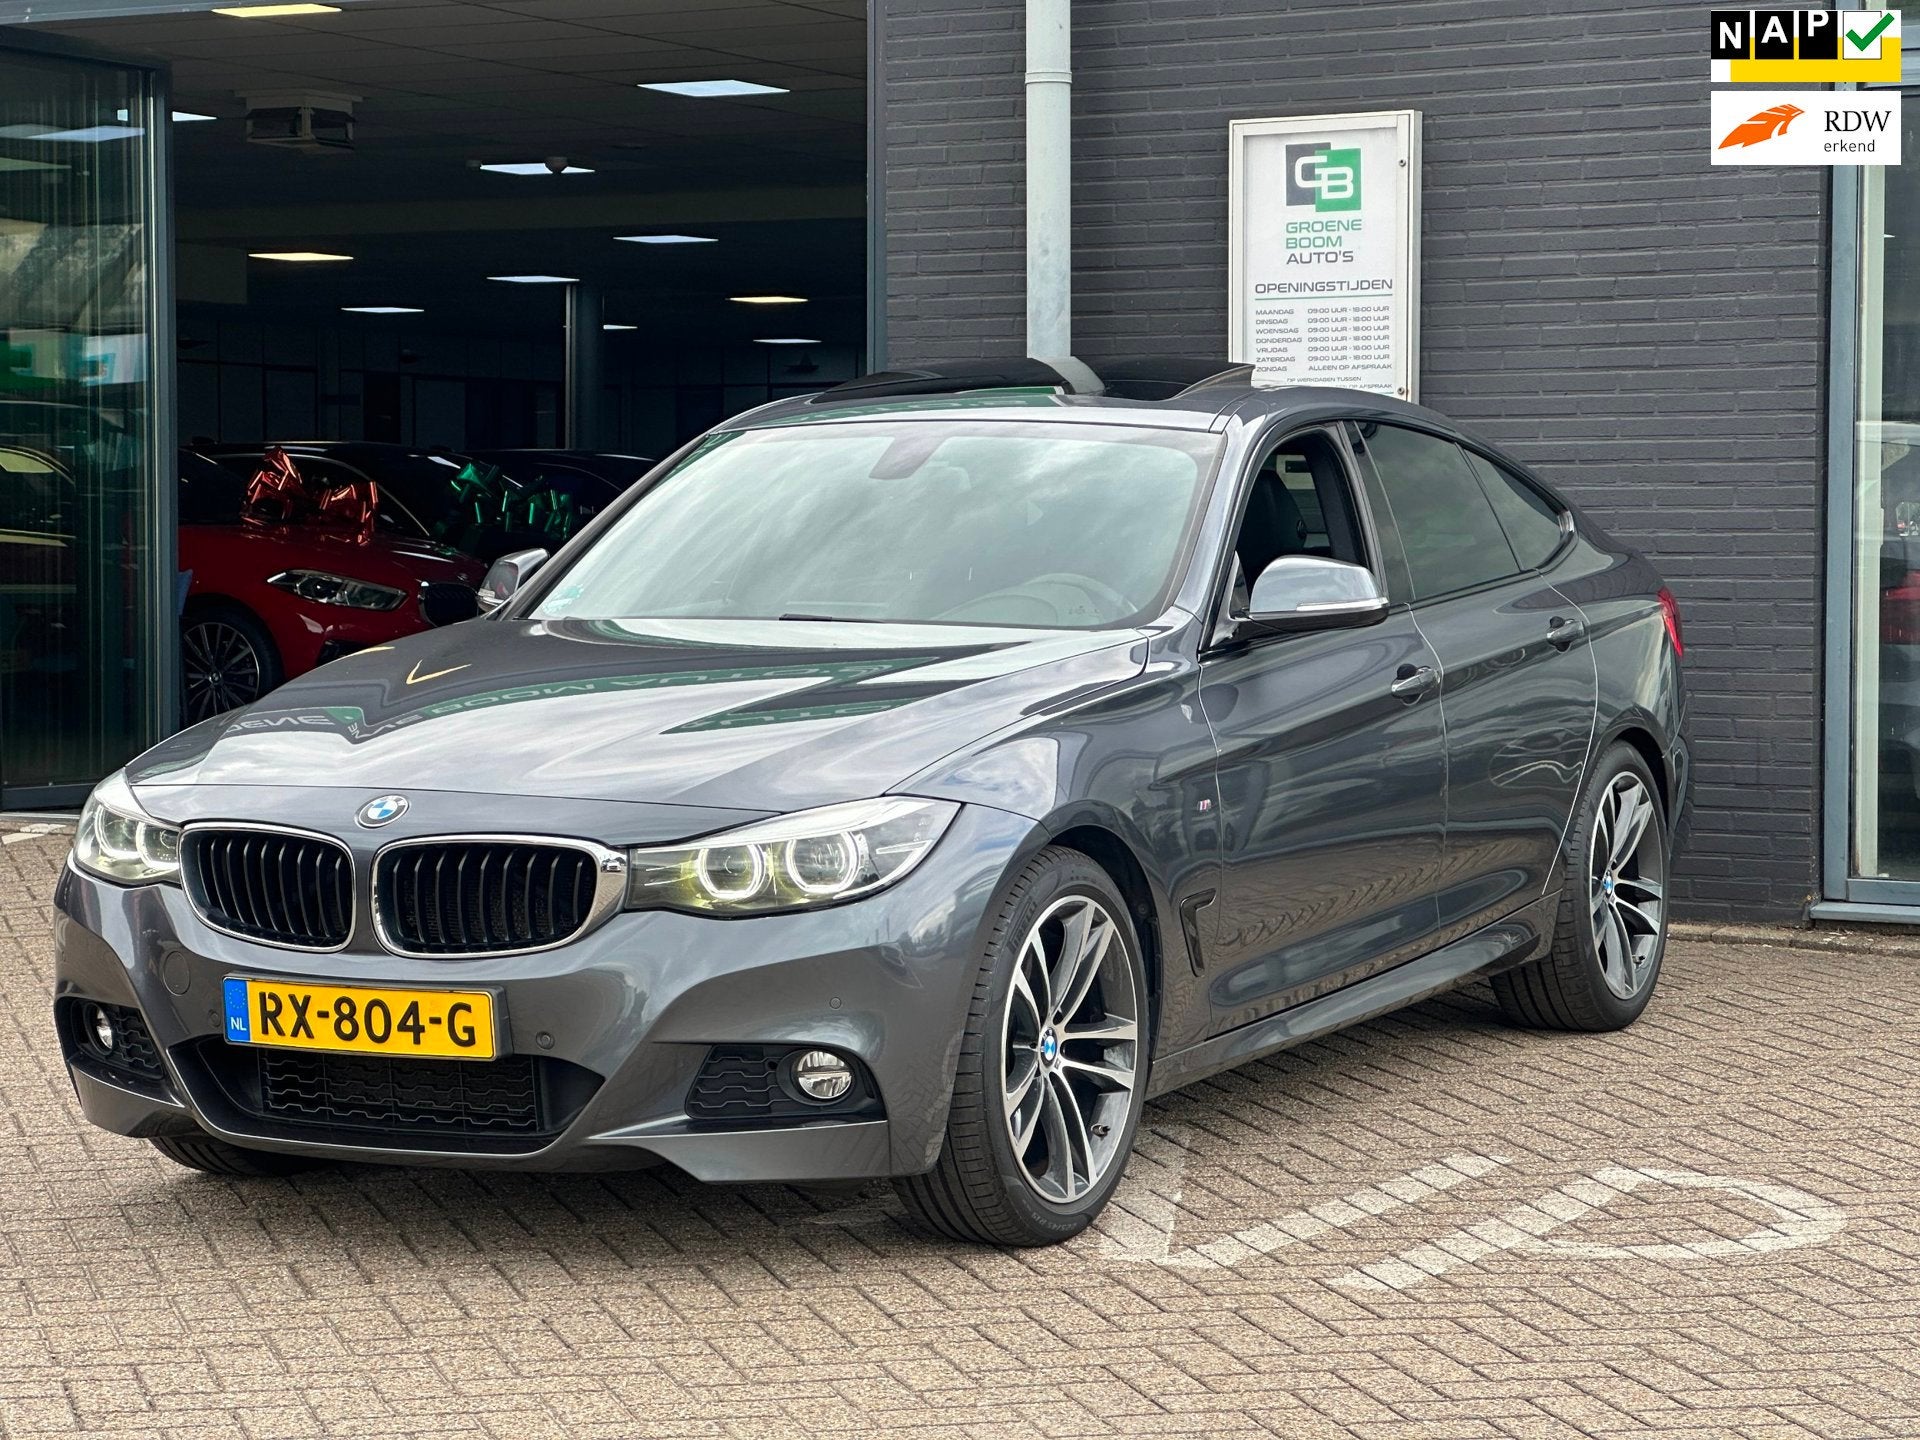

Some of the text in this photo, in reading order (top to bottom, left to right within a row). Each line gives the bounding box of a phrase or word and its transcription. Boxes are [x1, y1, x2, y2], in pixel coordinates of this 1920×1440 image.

[1285, 219, 1362, 234] GROENE
[1285, 235, 1342, 249] BOOM
[1286, 250, 1354, 265] AUTO'S
[1255, 278, 1393, 294] OPENINGSTIJDEN
[230, 1016, 247, 1031] NL
[259, 991, 476, 1047] RX-804-G
